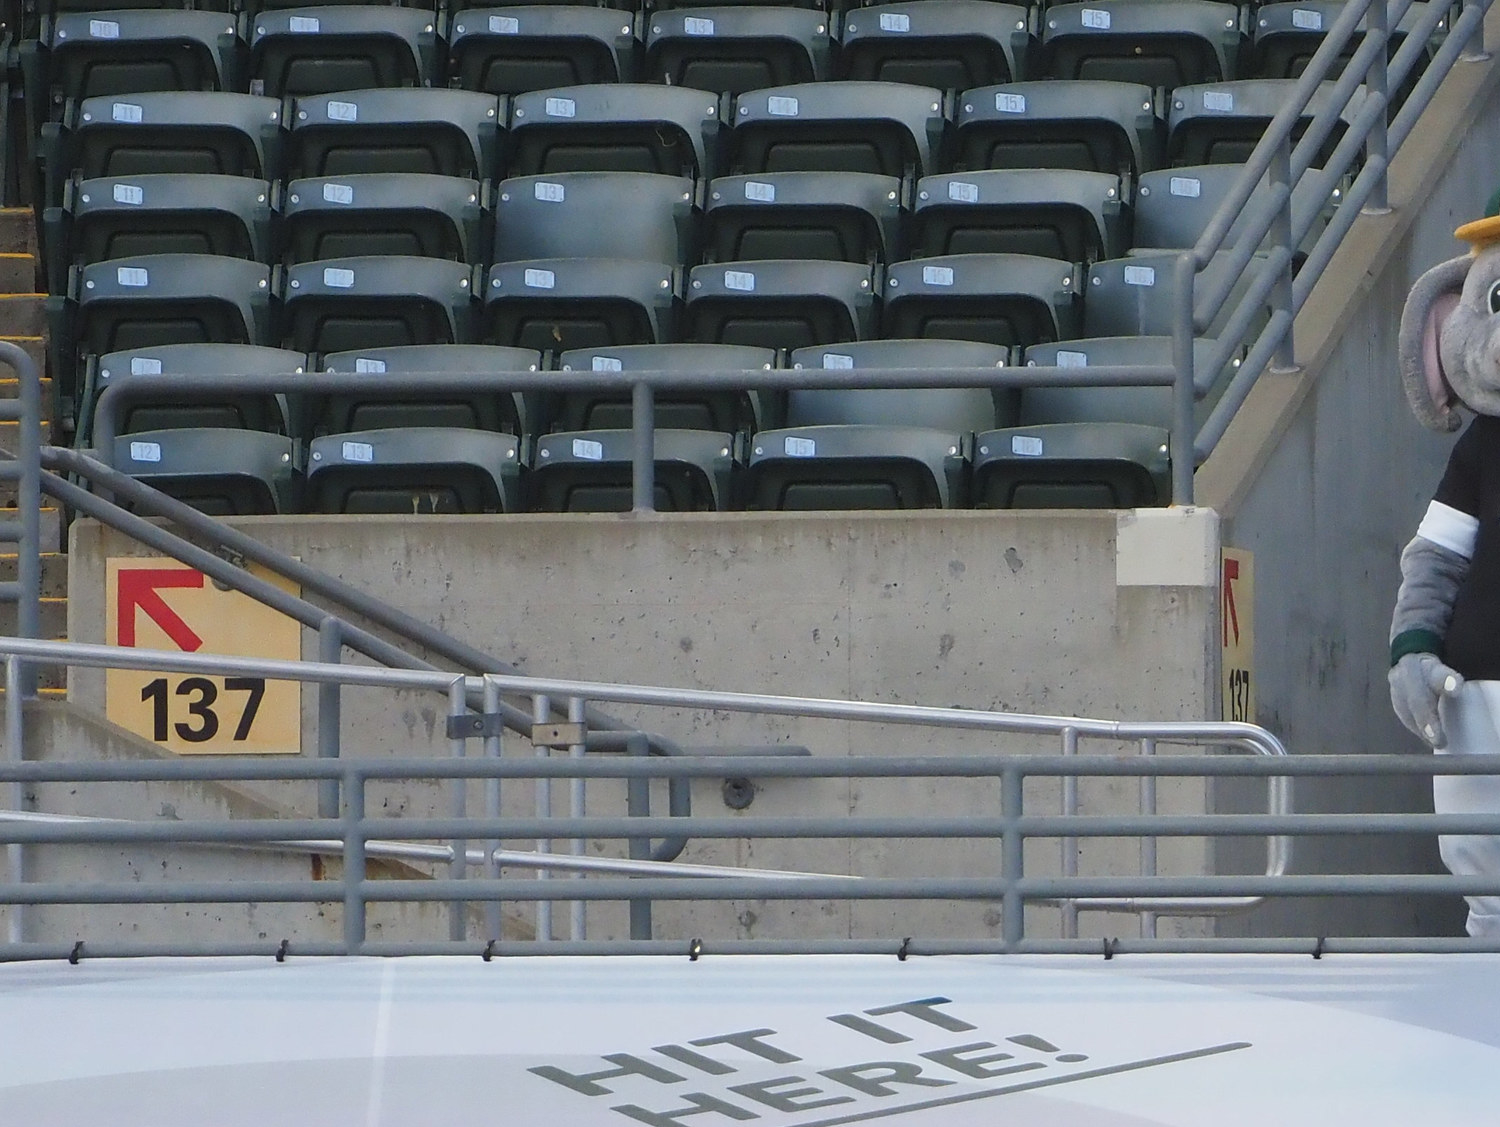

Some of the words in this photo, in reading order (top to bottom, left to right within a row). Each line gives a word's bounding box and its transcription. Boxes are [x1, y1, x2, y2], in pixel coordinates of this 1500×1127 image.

[1091, 11, 1103, 27] 15
[336, 104, 349, 118] 12
[555, 100, 567, 115] 13
[1005, 96, 1017, 111] 15
[332, 186, 345, 201] 12
[543, 185, 557, 200] 13
[139, 444, 153, 459] 12
[351, 444, 365, 460] 13
[1229, 668, 1249, 722] 137
[140, 677, 266, 742] 137
[526, 1027, 803, 1097] HIT
[825, 996, 978, 1045] IT
